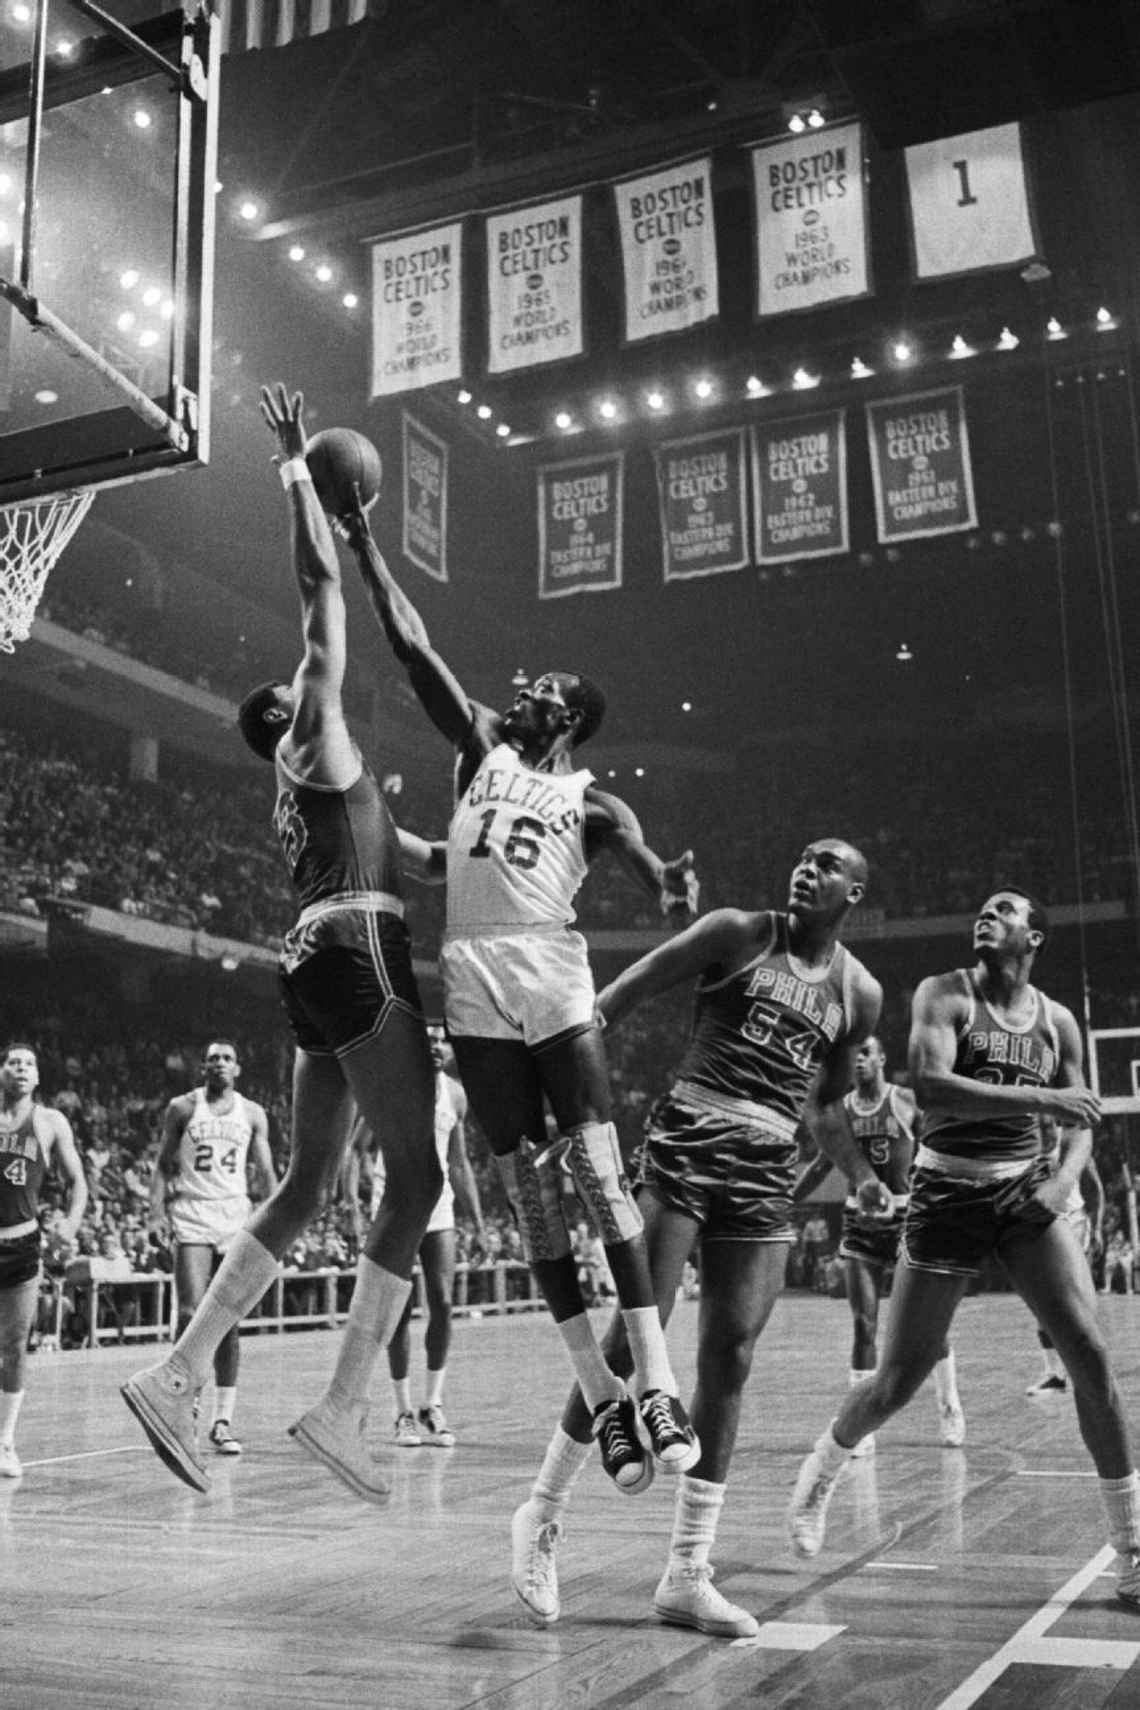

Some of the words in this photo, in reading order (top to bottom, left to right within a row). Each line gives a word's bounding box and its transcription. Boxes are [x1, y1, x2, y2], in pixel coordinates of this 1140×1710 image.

[769, 147, 846, 188] BOSTON
[952, 159, 977, 208] 1
[630, 177, 704, 219] BOSTON
[771, 173, 847, 213] CELTICS
[499, 216, 569, 252] BOSTON
[634, 202, 705, 245] CELTICS
[384, 244, 450, 280] BOSTON
[499, 241, 570, 277] CELTICS
[384, 268, 450, 303] CELTICS
[885, 409, 949, 439] BOSTON
[768, 432, 828, 462] BOSTON
[888, 430, 950, 460] CELTICS
[669, 452, 727, 479] BOSTON
[769, 453, 829, 482] CELTICS
[553, 472, 608, 501] BOSTON
[669, 472, 728, 499] CELTICS
[552, 493, 608, 521] CELTICS
[469, 769, 580, 835] CELTICS
[469, 809, 546, 870] 16
[744, 967, 843, 1042] PHILA
[740, 1001, 820, 1070] 54
[969, 1031, 1054, 1083] PHILA
[4, 1158, 26, 1186] 4
[194, 1145, 237, 1174] 24
